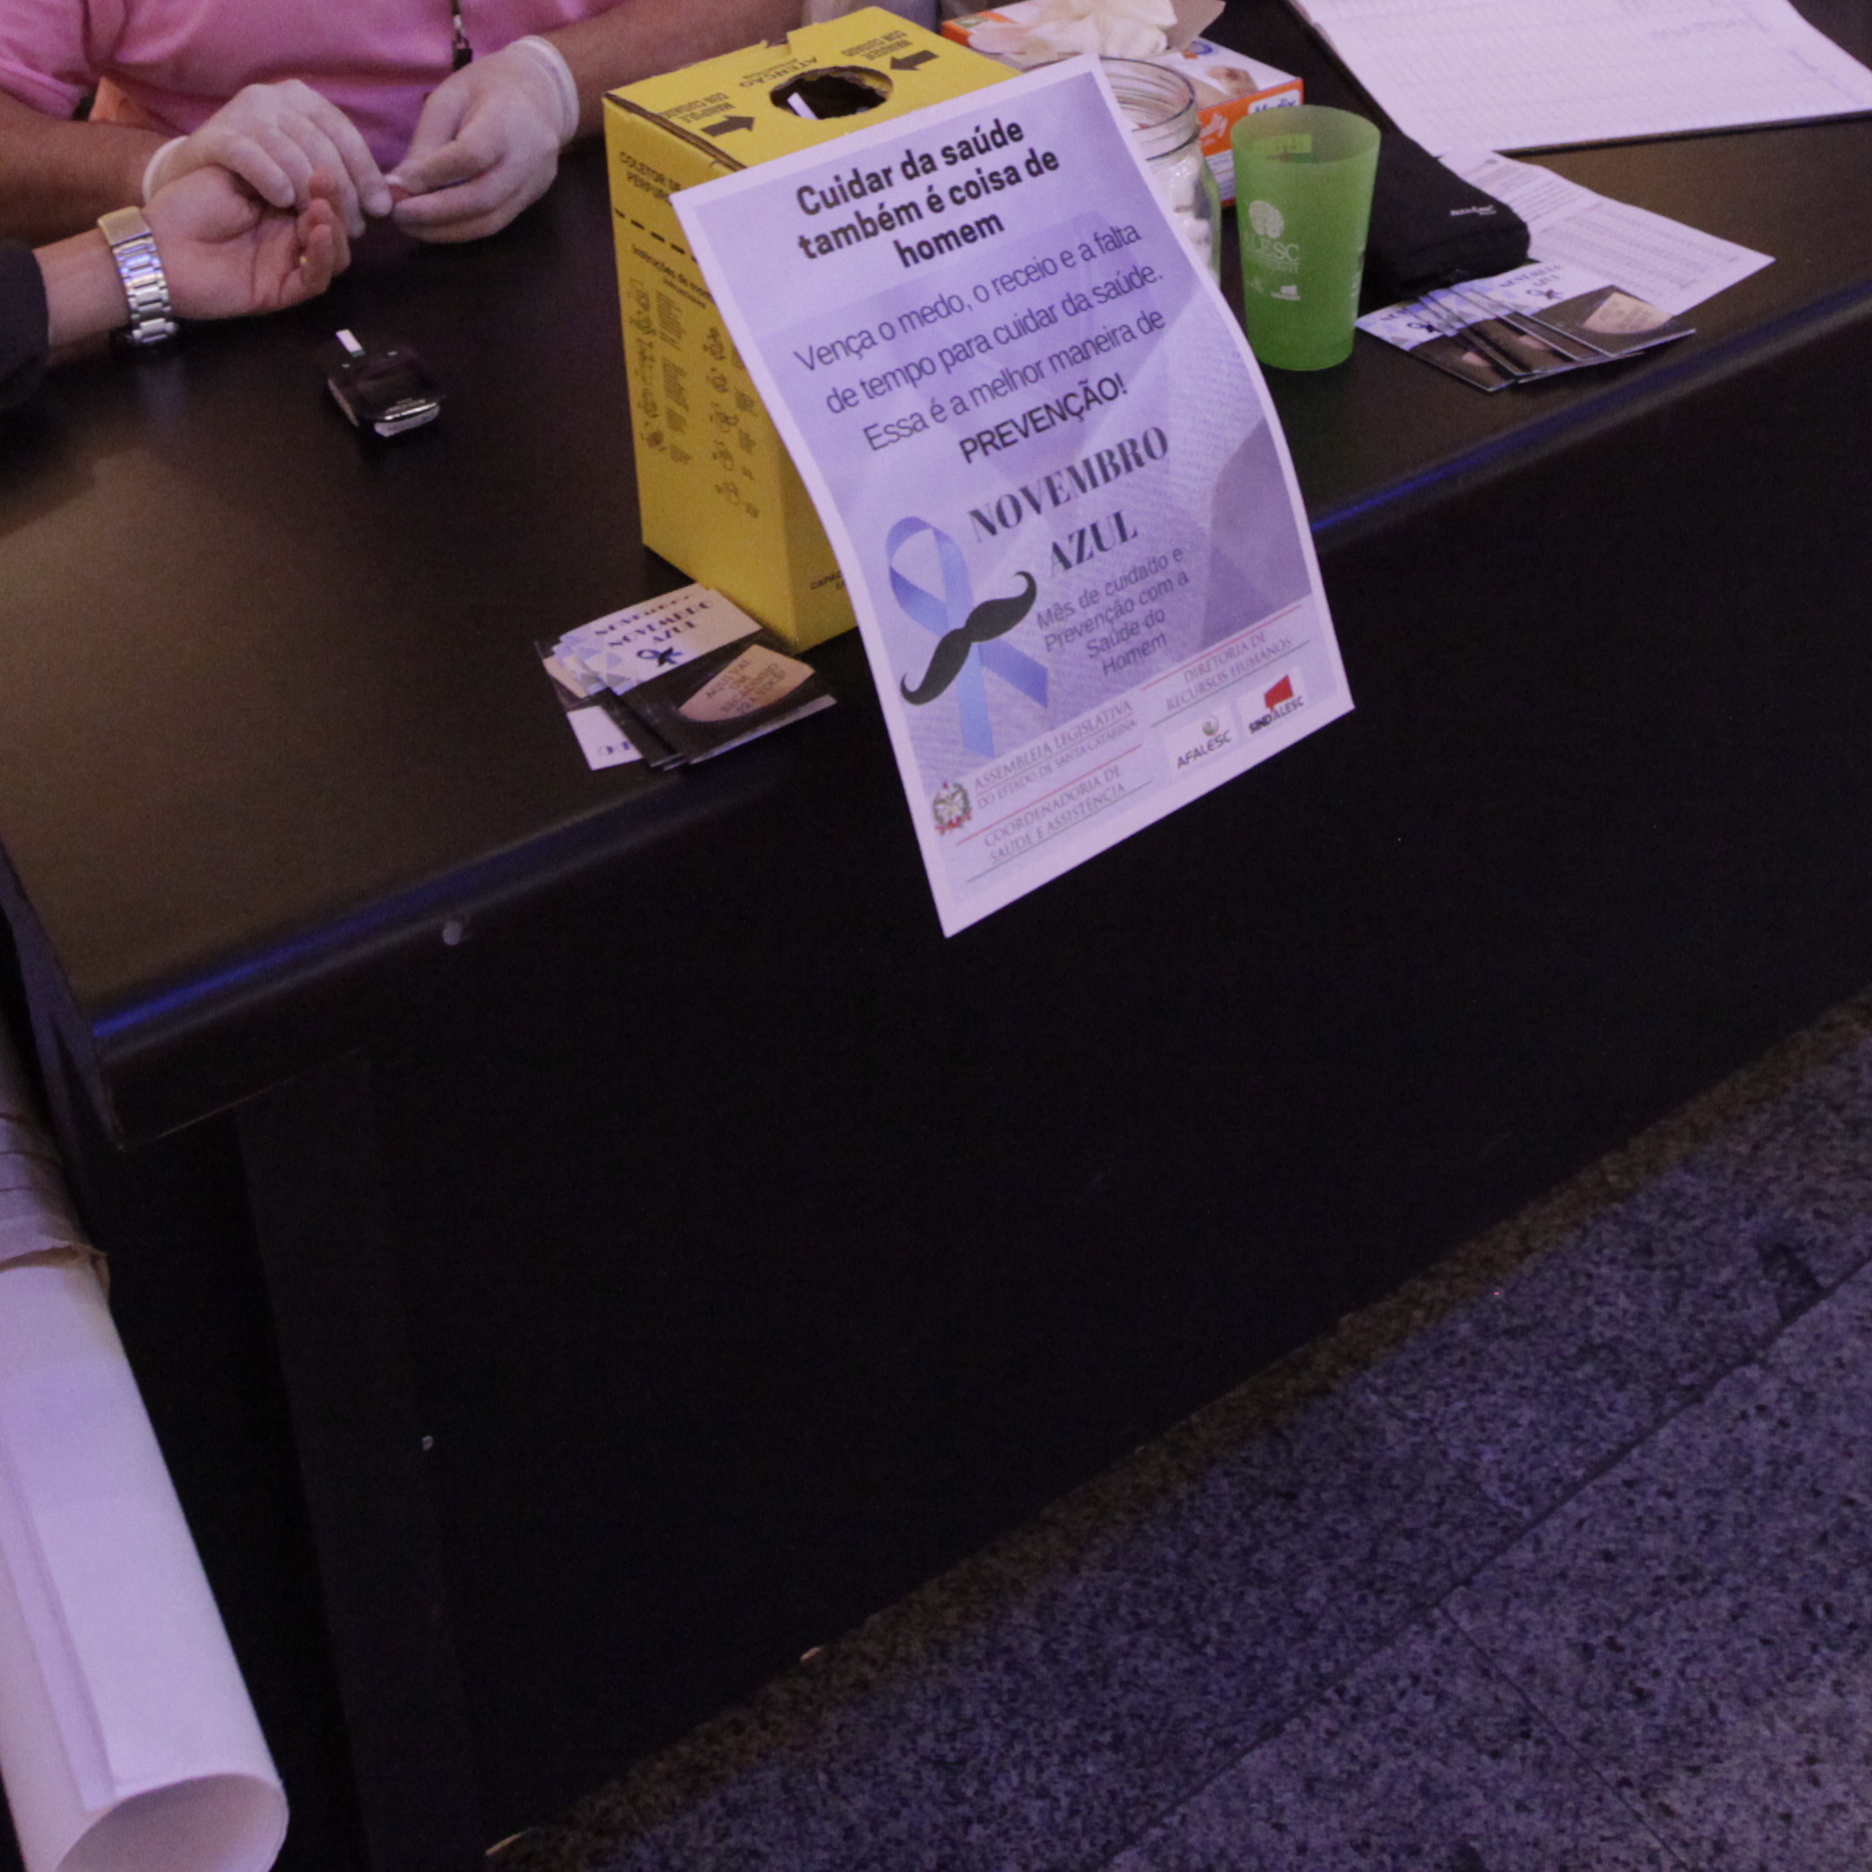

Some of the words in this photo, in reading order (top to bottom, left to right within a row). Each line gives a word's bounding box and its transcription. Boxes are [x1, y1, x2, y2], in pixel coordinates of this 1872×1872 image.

[796, 168, 893, 216] Cuidar
[900, 149, 938, 181] da
[941, 118, 1024, 166] saúde
[798, 202, 924, 259] também
[927, 184, 946, 214] é
[948, 168, 1022, 206] coisa
[1025, 148, 1060, 178] de
[893, 213, 1004, 268] homem
[793, 327, 877, 372] Vença
[878, 322, 896, 341] o
[897, 291, 972, 333] medo,
[972, 283, 990, 303] o
[991, 255, 1058, 297] receio
[1060, 249, 1076, 269] e
[1079, 243, 1096, 262] a
[1096, 222, 1142, 255] falta
[826, 385, 859, 415] de
[860, 355, 937, 403] tempo
[937, 334, 994, 375] para
[994, 303, 1060, 346] cuidar
[1061, 289, 1094, 318] da
[1093, 262, 1164, 305] saúde.
[863, 413, 930, 452] Essa
[931, 399, 950, 425] é
[949, 393, 970, 413] a
[969, 362, 1045, 408] melhor
[1048, 322, 1138, 375] maneira
[1137, 308, 1167, 335] de
[959, 371, 1129, 464] PREVENÇÃO!
[968, 426, 1168, 544] NOVEMBRO
[1051, 509, 1138, 576] AZUL
[1036, 598, 1076, 630] Mês
[1079, 586, 1100, 610] de
[1104, 553, 1169, 597] cuidado
[1172, 547, 1184, 562] e
[1044, 600, 1135, 653] Prevenção
[1138, 577, 1174, 606] com
[1177, 571, 1190, 586] a
[1085, 621, 1142, 659] Saúde
[1144, 607, 1166, 629] do
[1102, 633, 1168, 676] Homem
[1166, 671, 1229, 711] RECURSOS
[1229, 636, 1292, 678] HUMANOS
[1183, 642, 1249, 684] DIRETORIA
[1251, 631, 1267, 647] DE
[974, 742, 1053, 789] ASSEMBLEIA
[1053, 699, 1133, 747] LEGISLATIVA
[1178, 730, 1232, 770] AFALESC
[1248, 695, 1305, 735] SINDALESC
[977, 794, 996, 810] DO
[998, 775, 1037, 799] ESTADO
[1039, 762, 1053, 776] DE
[1054, 745, 1087, 769] SANTA
[1087, 719, 1138, 751] CATARINA
[983, 776, 1101, 848] COORDENADORIA
[1103, 764, 1122, 780] DE
[1036, 825, 1045, 840] E
